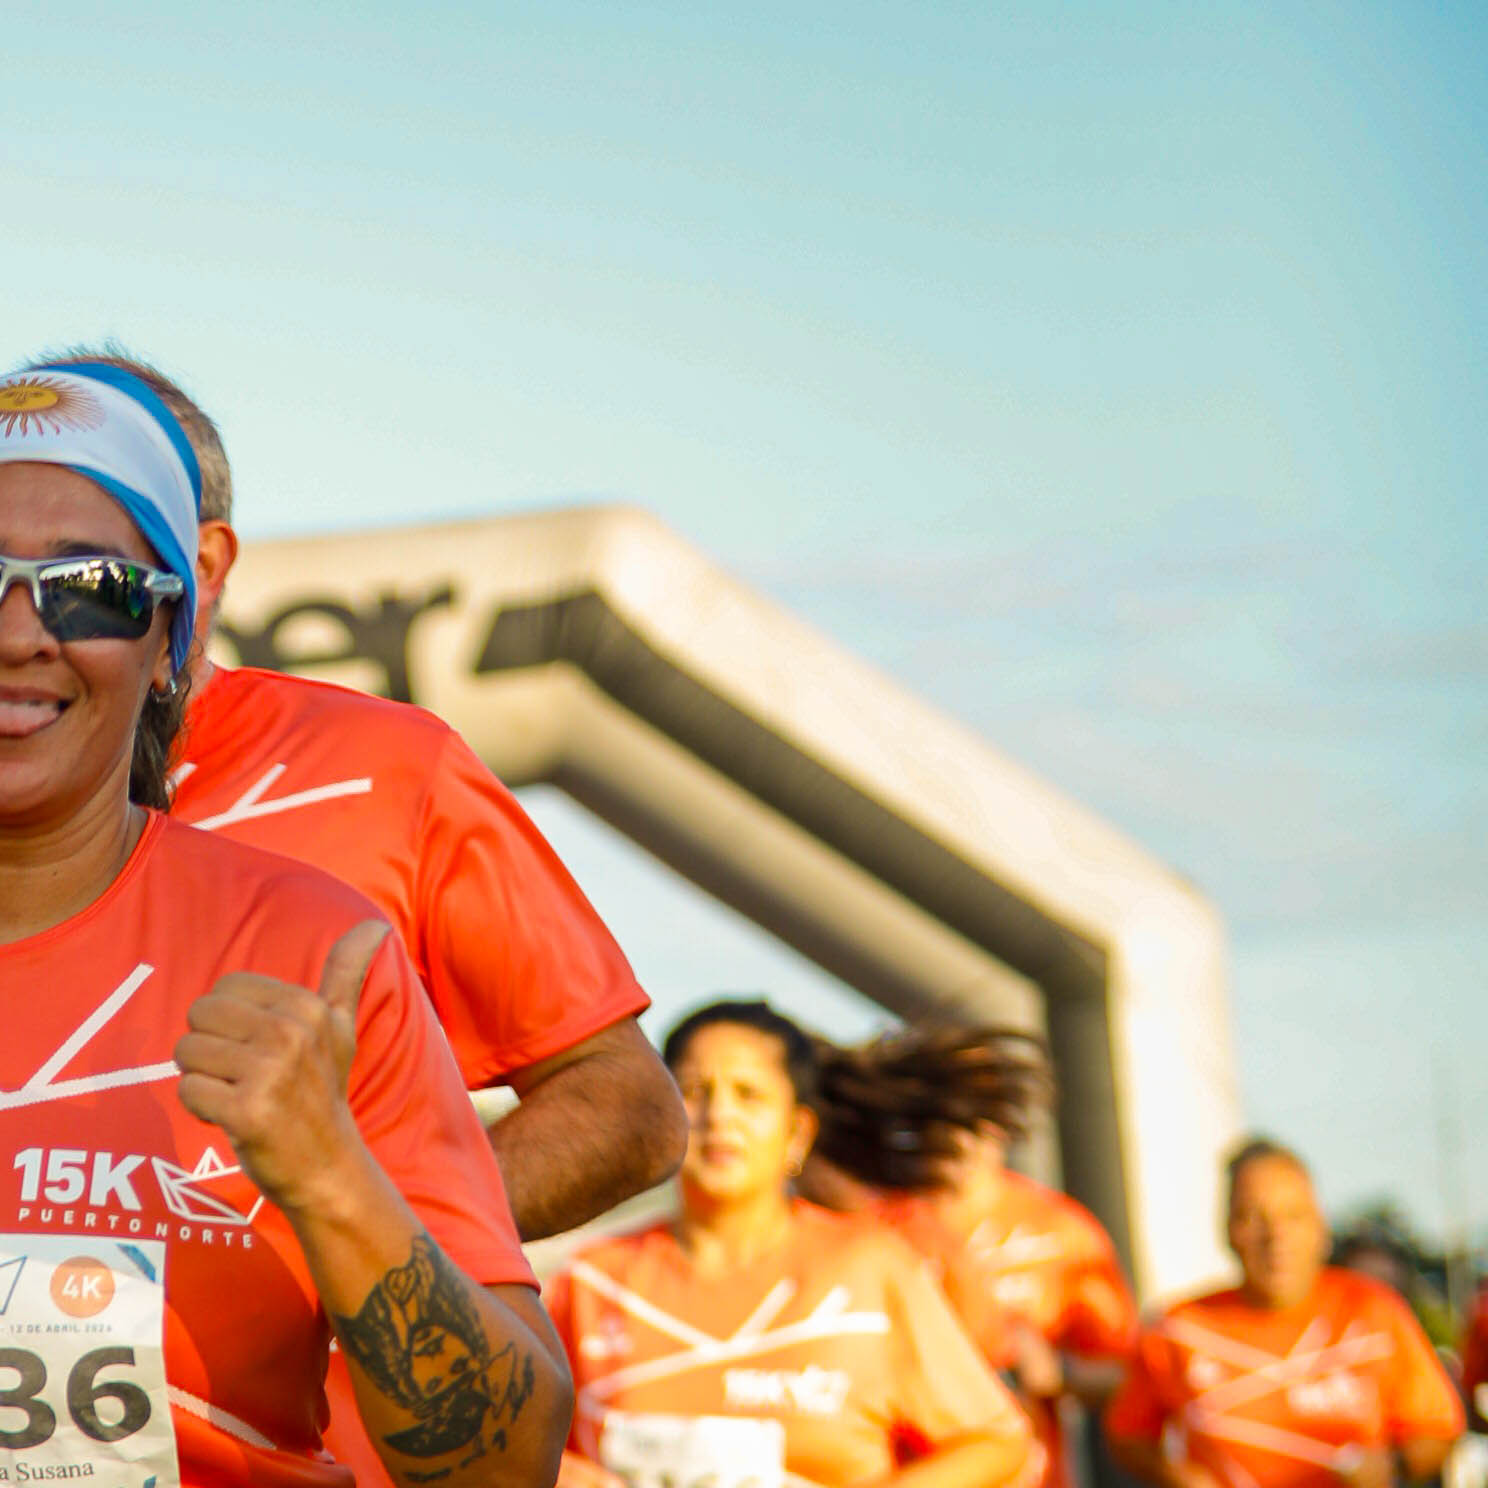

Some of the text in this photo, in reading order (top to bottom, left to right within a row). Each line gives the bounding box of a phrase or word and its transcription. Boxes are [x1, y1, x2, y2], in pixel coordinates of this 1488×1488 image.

[13, 1147, 146, 1211] 15K
[61, 1272, 104, 1299] 4K
[15, 1461, 95, 1482] Susana
